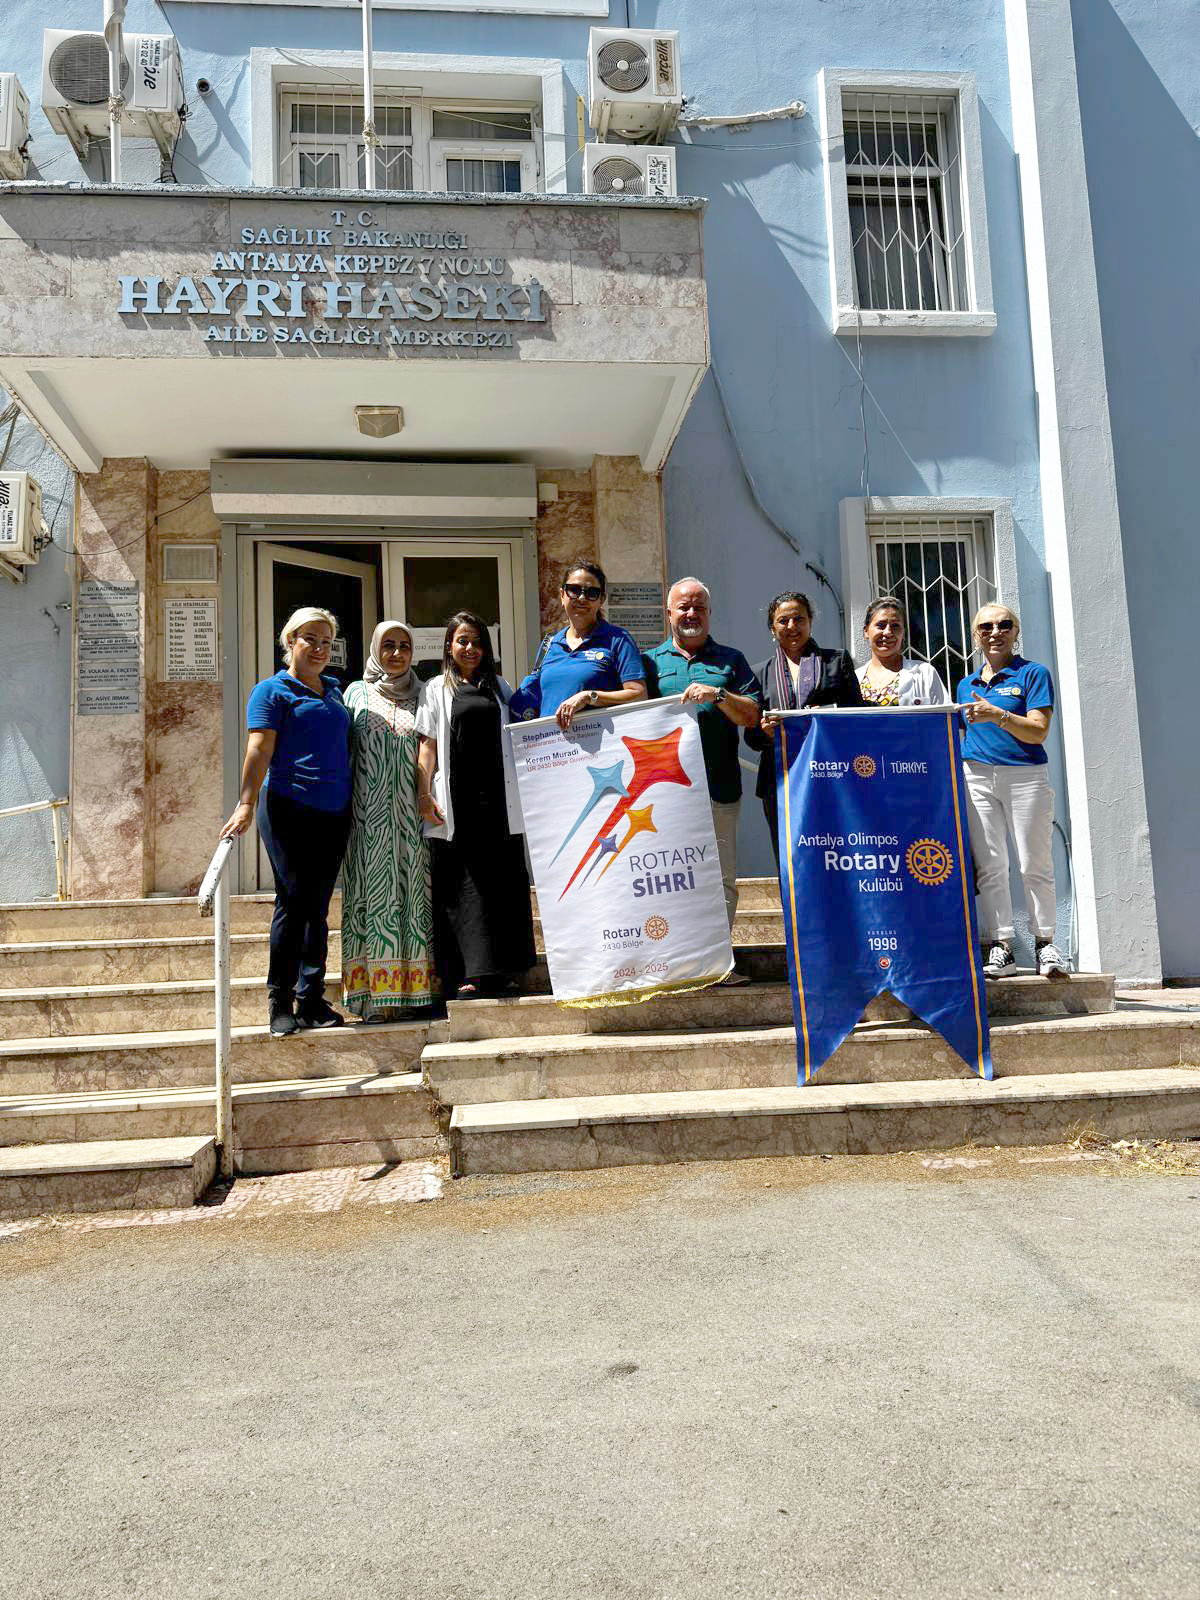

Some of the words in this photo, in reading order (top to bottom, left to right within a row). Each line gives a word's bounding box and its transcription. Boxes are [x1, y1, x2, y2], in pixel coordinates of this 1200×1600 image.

[241, 224, 332, 246] SAĞLIK
[343, 230, 468, 250] BAKANLIĞI
[211, 251, 327, 273] ANTALYA
[334, 254, 416, 275] KEPEZ
[420, 256, 435, 275] 7
[440, 255, 506, 276] NOLU
[117, 273, 306, 318] HAYRİ
[322, 277, 546, 322] HASEKİ
[522, 728, 561, 743] Stephanie
[571, 722, 602, 733] Urchick
[525, 755, 551, 766] Kerem
[809, 760, 850, 773] Rotary
[890, 760, 928, 774] TÜRKİYE
[798, 833, 844, 849] Antalya
[848, 832, 899, 848] Olimpos
[629, 845, 708, 873] ROTARY
[824, 850, 901, 874] Rotary
[632, 866, 696, 898] SİHRİ
[858, 878, 904, 892] Kulübü
[603, 926, 642, 941] Rotary
[622, 939, 645, 950] Bölge
[868, 937, 898, 951] 1998
[613, 967, 636, 979] 2024
[644, 962, 669, 975] 2025
